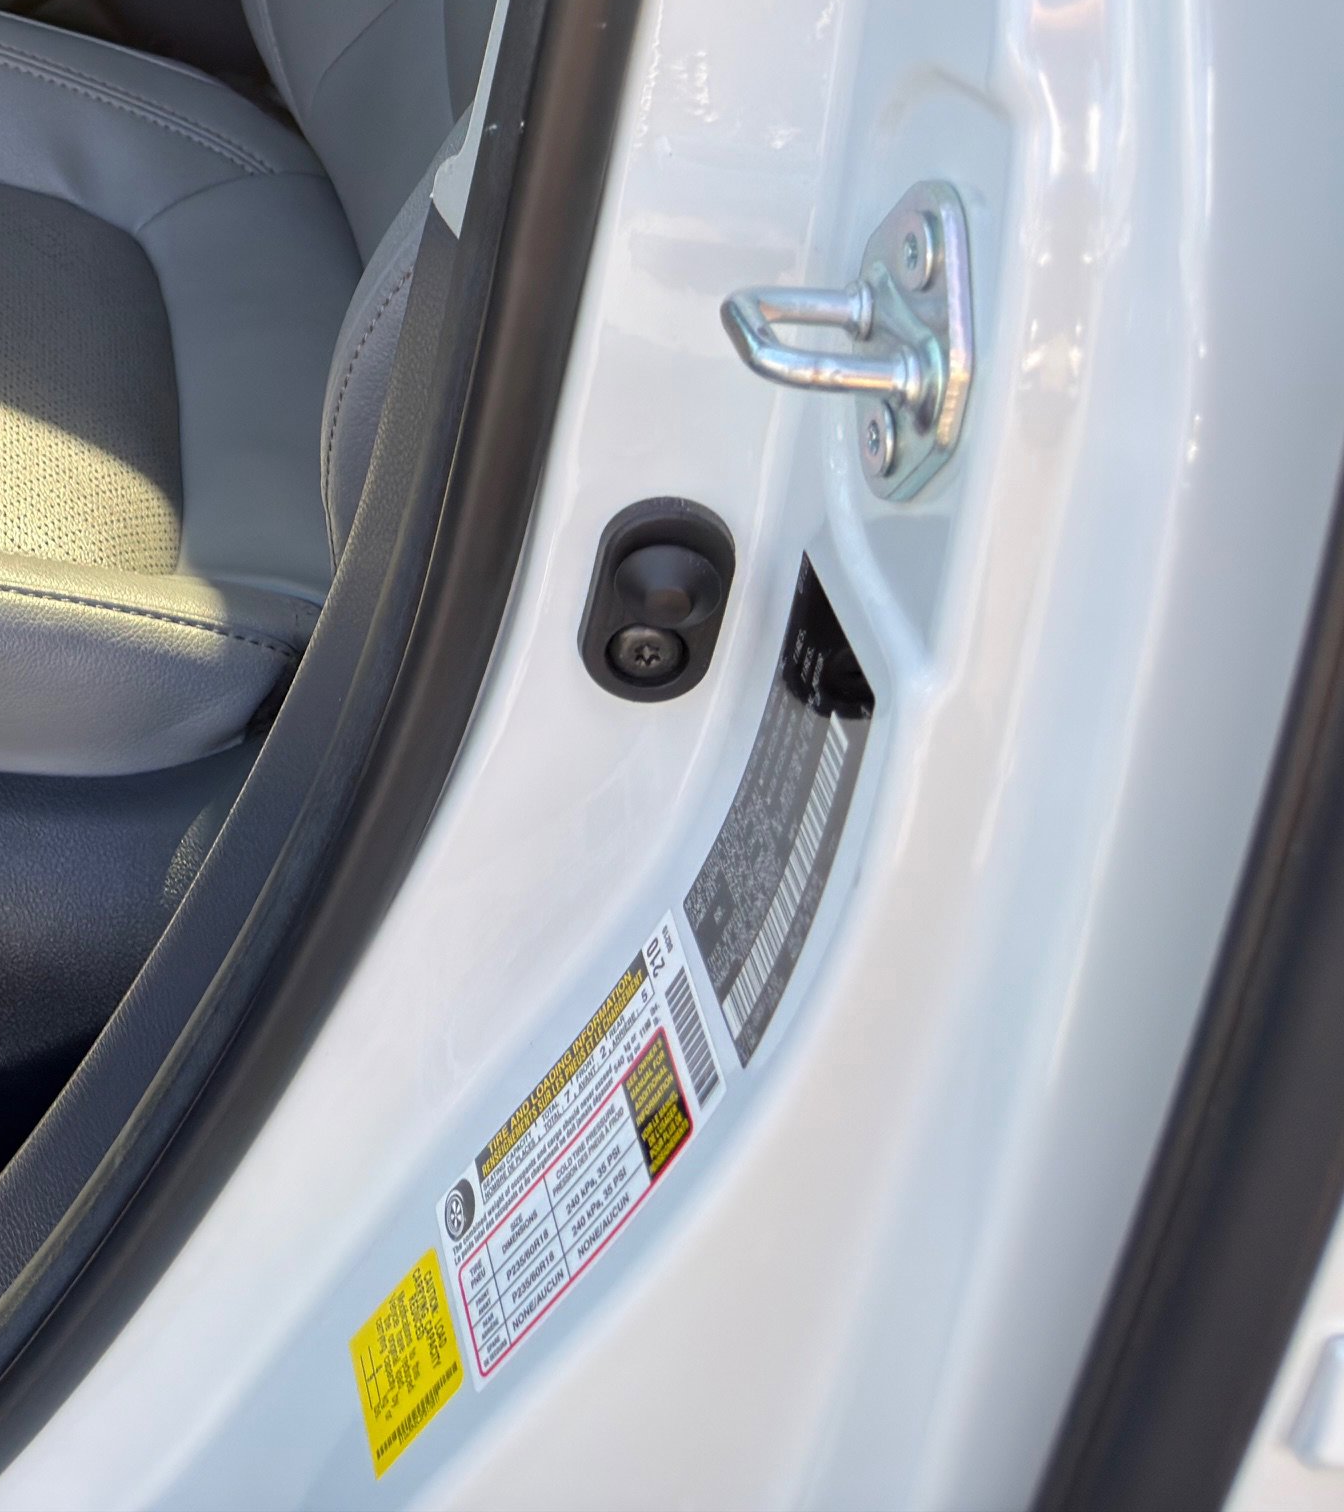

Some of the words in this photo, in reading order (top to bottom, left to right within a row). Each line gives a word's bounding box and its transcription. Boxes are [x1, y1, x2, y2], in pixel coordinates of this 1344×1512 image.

[646, 936, 665, 978] 210
[640, 988, 648, 1003] 5
[608, 1014, 625, 1039] REAR
[481, 1103, 537, 1180] RENSEIGNEMENTS
[536, 1088, 552, 1112] SUR
[551, 1073, 565, 1095] LES
[563, 1046, 586, 1079] PNEUS
[584, 1035, 594, 1054] ET
[593, 1024, 603, 1043] LE
[600, 969, 644, 1031] CHARGEMENT
[486, 1123, 508, 1153] TIRE
[510, 1100, 529, 1130] AND
[530, 1049, 571, 1104] LOADING
[571, 970, 633, 1053] INFORMATION
[575, 1053, 594, 1082] FRONT
[599, 1044, 607, 1059] 2
[613, 1054, 625, 1073] 540
[629, 1067, 653, 1100] MANUAL
[651, 1049, 665, 1069] FOR
[563, 1088, 570, 1104] 7
[577, 1063, 596, 1092] AVANT
[634, 1065, 667, 1111] ADDITIONAL
[635, 1072, 673, 1125] INFORMATION
[540, 1100, 559, 1122] TOTAL
[543, 1109, 562, 1133] TOTAL
[452, 1241, 462, 1255] The
[462, 1212, 487, 1245] combined
[486, 1192, 505, 1217] weight
[504, 1184, 510, 1197] of
[510, 1157, 536, 1190] occupants
[536, 1143, 547, 1161] and
[546, 1128, 562, 1148] cargo
[561, 1105, 580, 1131] should
[579, 1088, 594, 1109] never
[594, 1063, 612, 1092] exceed
[482, 1160, 506, 1191] SEATING
[505, 1129, 531, 1164] CAPACITY
[551, 1163, 578, 1197] PRESSION
[576, 1151, 588, 1168] DES
[587, 1130, 605, 1155] PNEUS
[608, 1106, 624, 1129] FROID
[555, 1156, 573, 1180] COLD
[571, 1141, 586, 1160] TIRE
[585, 1103, 615, 1145] PRESSURE
[565, 1193, 580, 1215] 240
[596, 1161, 607, 1178] 35
[606, 1144, 620, 1166] PSI
[571, 1215, 586, 1237] 240
[602, 1183, 613, 1200] 35
[612, 1166, 627, 1188] PSI
[501, 1209, 538, 1254] DIMENSIONS
[510, 1213, 523, 1232] SIZE
[577, 1192, 629, 1258] NONE/AUCUN
[468, 1258, 482, 1276] TIRE
[470, 1266, 486, 1289] PNEU
[505, 1228, 549, 1281] P235/60R18
[511, 1250, 554, 1303] P235/60R18
[408, 1292, 425, 1341] REDUCED
[411, 1266, 429, 1319] CARRYING
[423, 1319, 441, 1368] CAPACITY
[511, 1268, 564, 1331] NONE/AUCUN
[433, 1317, 447, 1348] LOAD
